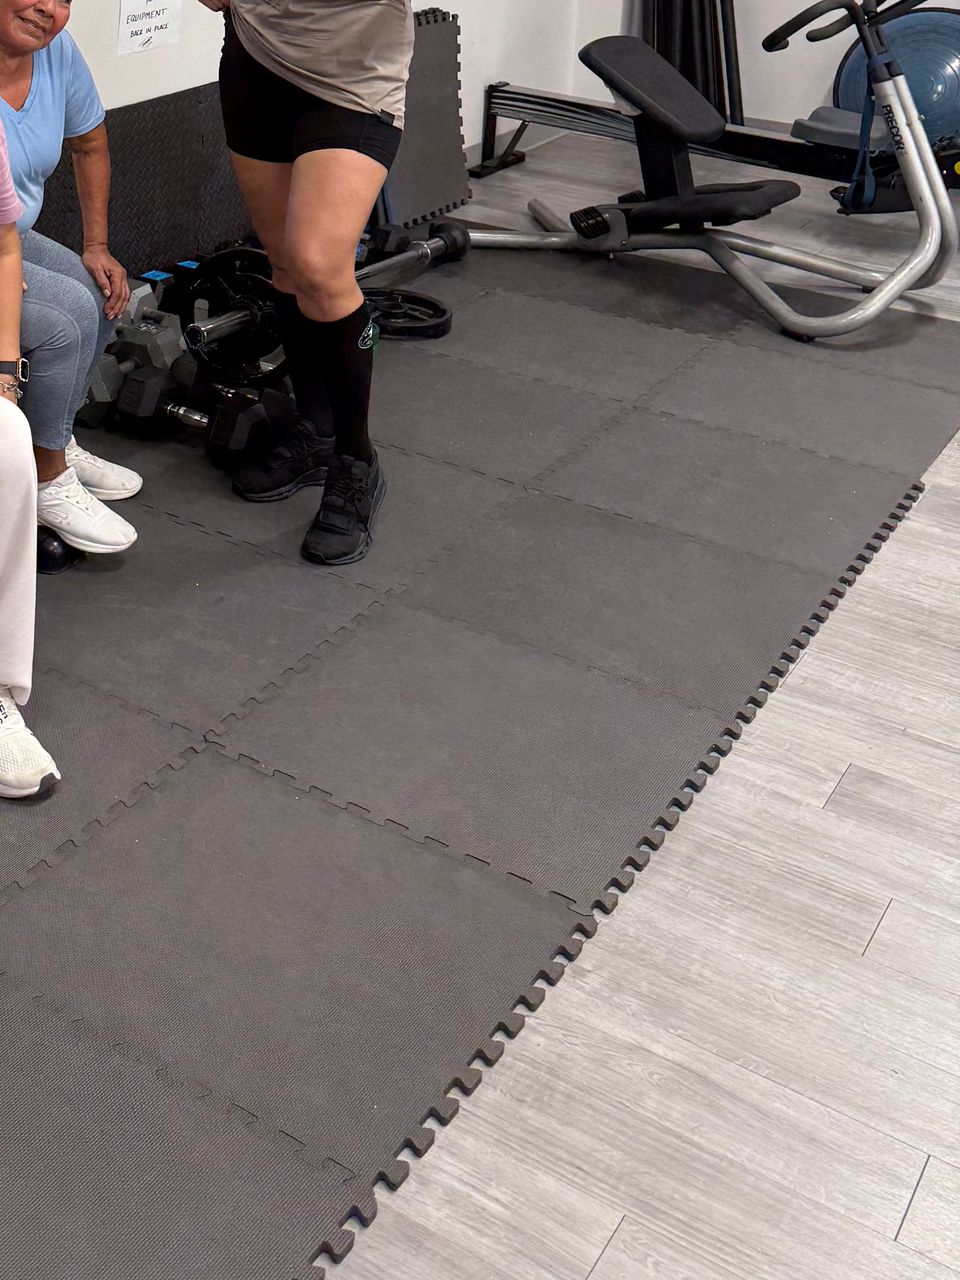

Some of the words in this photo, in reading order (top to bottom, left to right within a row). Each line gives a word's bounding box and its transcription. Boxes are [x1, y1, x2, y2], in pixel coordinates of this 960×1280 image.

[126, 7, 168, 25] EQUIPMENT
[130, 28, 143, 38] BACK
[154, 22, 169, 32] PLACE
[882, 104, 905, 151] PRECOR
